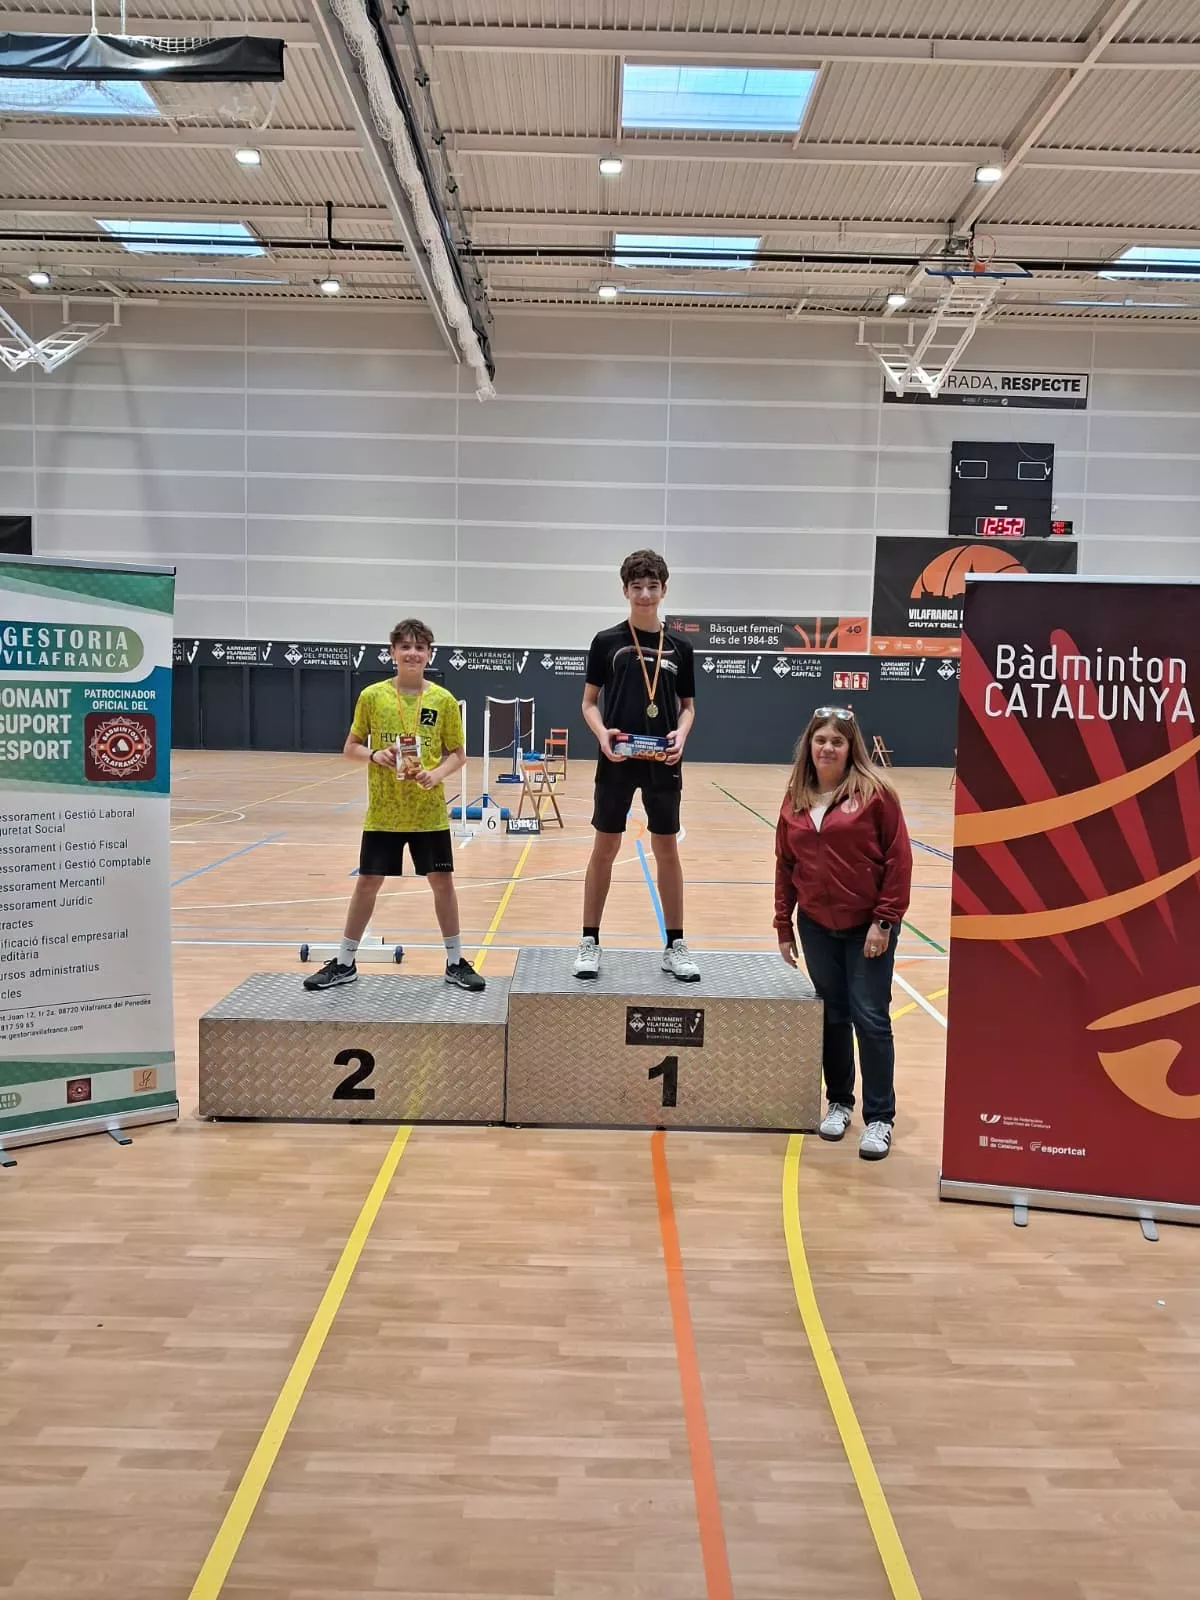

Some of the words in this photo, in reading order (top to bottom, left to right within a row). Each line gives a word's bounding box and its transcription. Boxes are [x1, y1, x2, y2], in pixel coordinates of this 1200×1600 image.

[1001, 376, 1081, 392] RESPECTE
[983, 517, 1024, 535] 12:52
[908, 608, 958, 620] VILAFRANCA
[709, 623, 748, 635] Bàsquet
[750, 623, 784, 633] femení
[3, 626, 129, 650] GESTORIA
[709, 635, 726, 644] des
[728, 635, 740, 645] de
[742, 635, 779, 645] 1984-85
[3, 650, 129, 668] VILAFRANCA
[996, 643, 1187, 684] Bàdminton
[0, 687, 72, 709] ONANT
[84, 689, 156, 700] PATROCINADOR
[92, 700, 129, 710] OFICIAL
[131, 701, 149, 711] DEL
[984, 682, 1196, 723] CATALUNYA
[101, 727, 140, 741] BADMINTON
[101, 752, 141, 768] VILAFRANCA
[64, 809, 96, 820] Gestió
[99, 808, 135, 818] Laboral
[487, 816, 497, 830] 6
[0, 825, 32, 837] uretat
[35, 824, 66, 834] Social
[64, 841, 96, 852] Gestió
[99, 839, 128, 849] Fiscal
[0, 861, 56, 873] ssorament
[64, 859, 96, 870] Gestió
[99, 856, 151, 868] Comptable
[59, 876, 105, 888] Mercantil
[59, 896, 94, 908] Jurídic
[1, 937, 39, 949] ificació
[41, 934, 69, 945] fiscal
[71, 928, 129, 943] empresarial
[1, 950, 39, 962] editària
[29, 963, 100, 978] administratius
[1, 989, 22, 1000] cles
[58, 1006, 79, 1015] 08720
[79, 1003, 112, 1012] Vilafranca
[332, 1048, 376, 1101] 2
[647, 1055, 679, 1107] 1
[1041, 1145, 1086, 1157] esportcat
